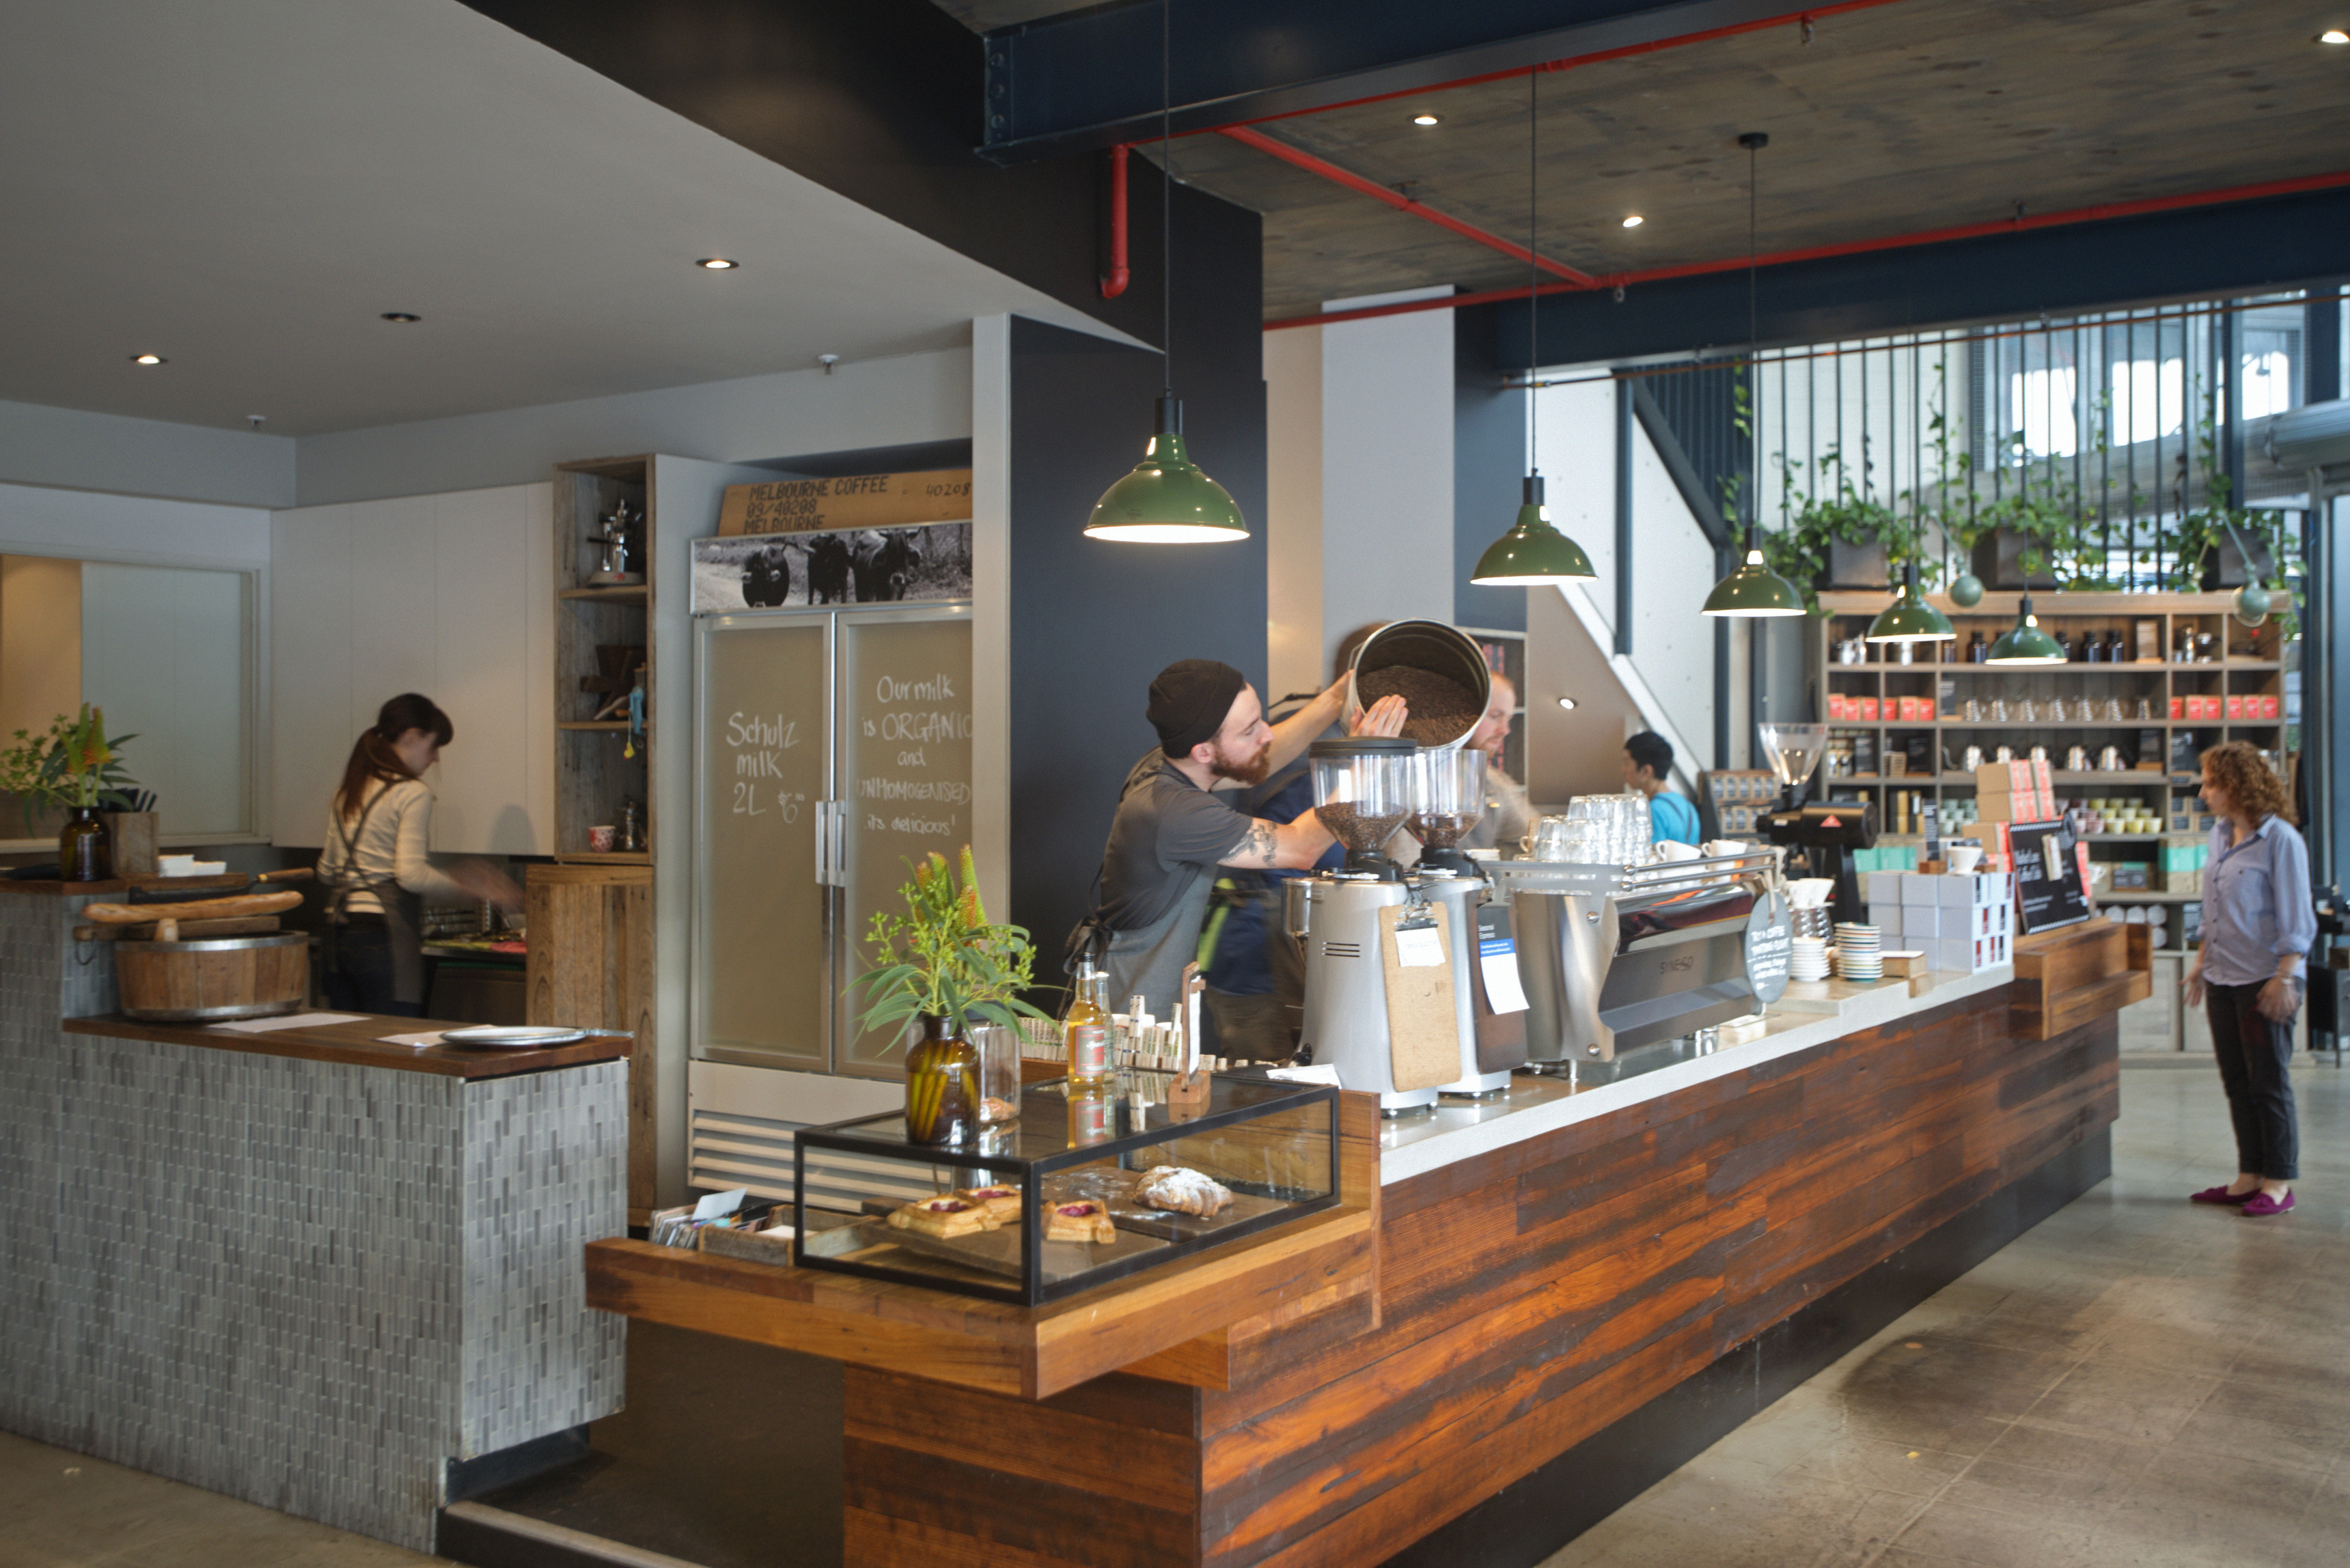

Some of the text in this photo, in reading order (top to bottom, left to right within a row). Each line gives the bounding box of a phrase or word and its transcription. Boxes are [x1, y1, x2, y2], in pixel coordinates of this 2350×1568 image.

[749, 475, 889, 502] MELBOURNE COFFEE
[926, 482, 971, 497] 40208
[743, 514, 825, 535] MELBOURNE
[876, 673, 955, 703] Our milk
[725, 711, 799, 748] Schulz
[861, 712, 972, 744] is ORGANIC
[897, 746, 926, 767] and
